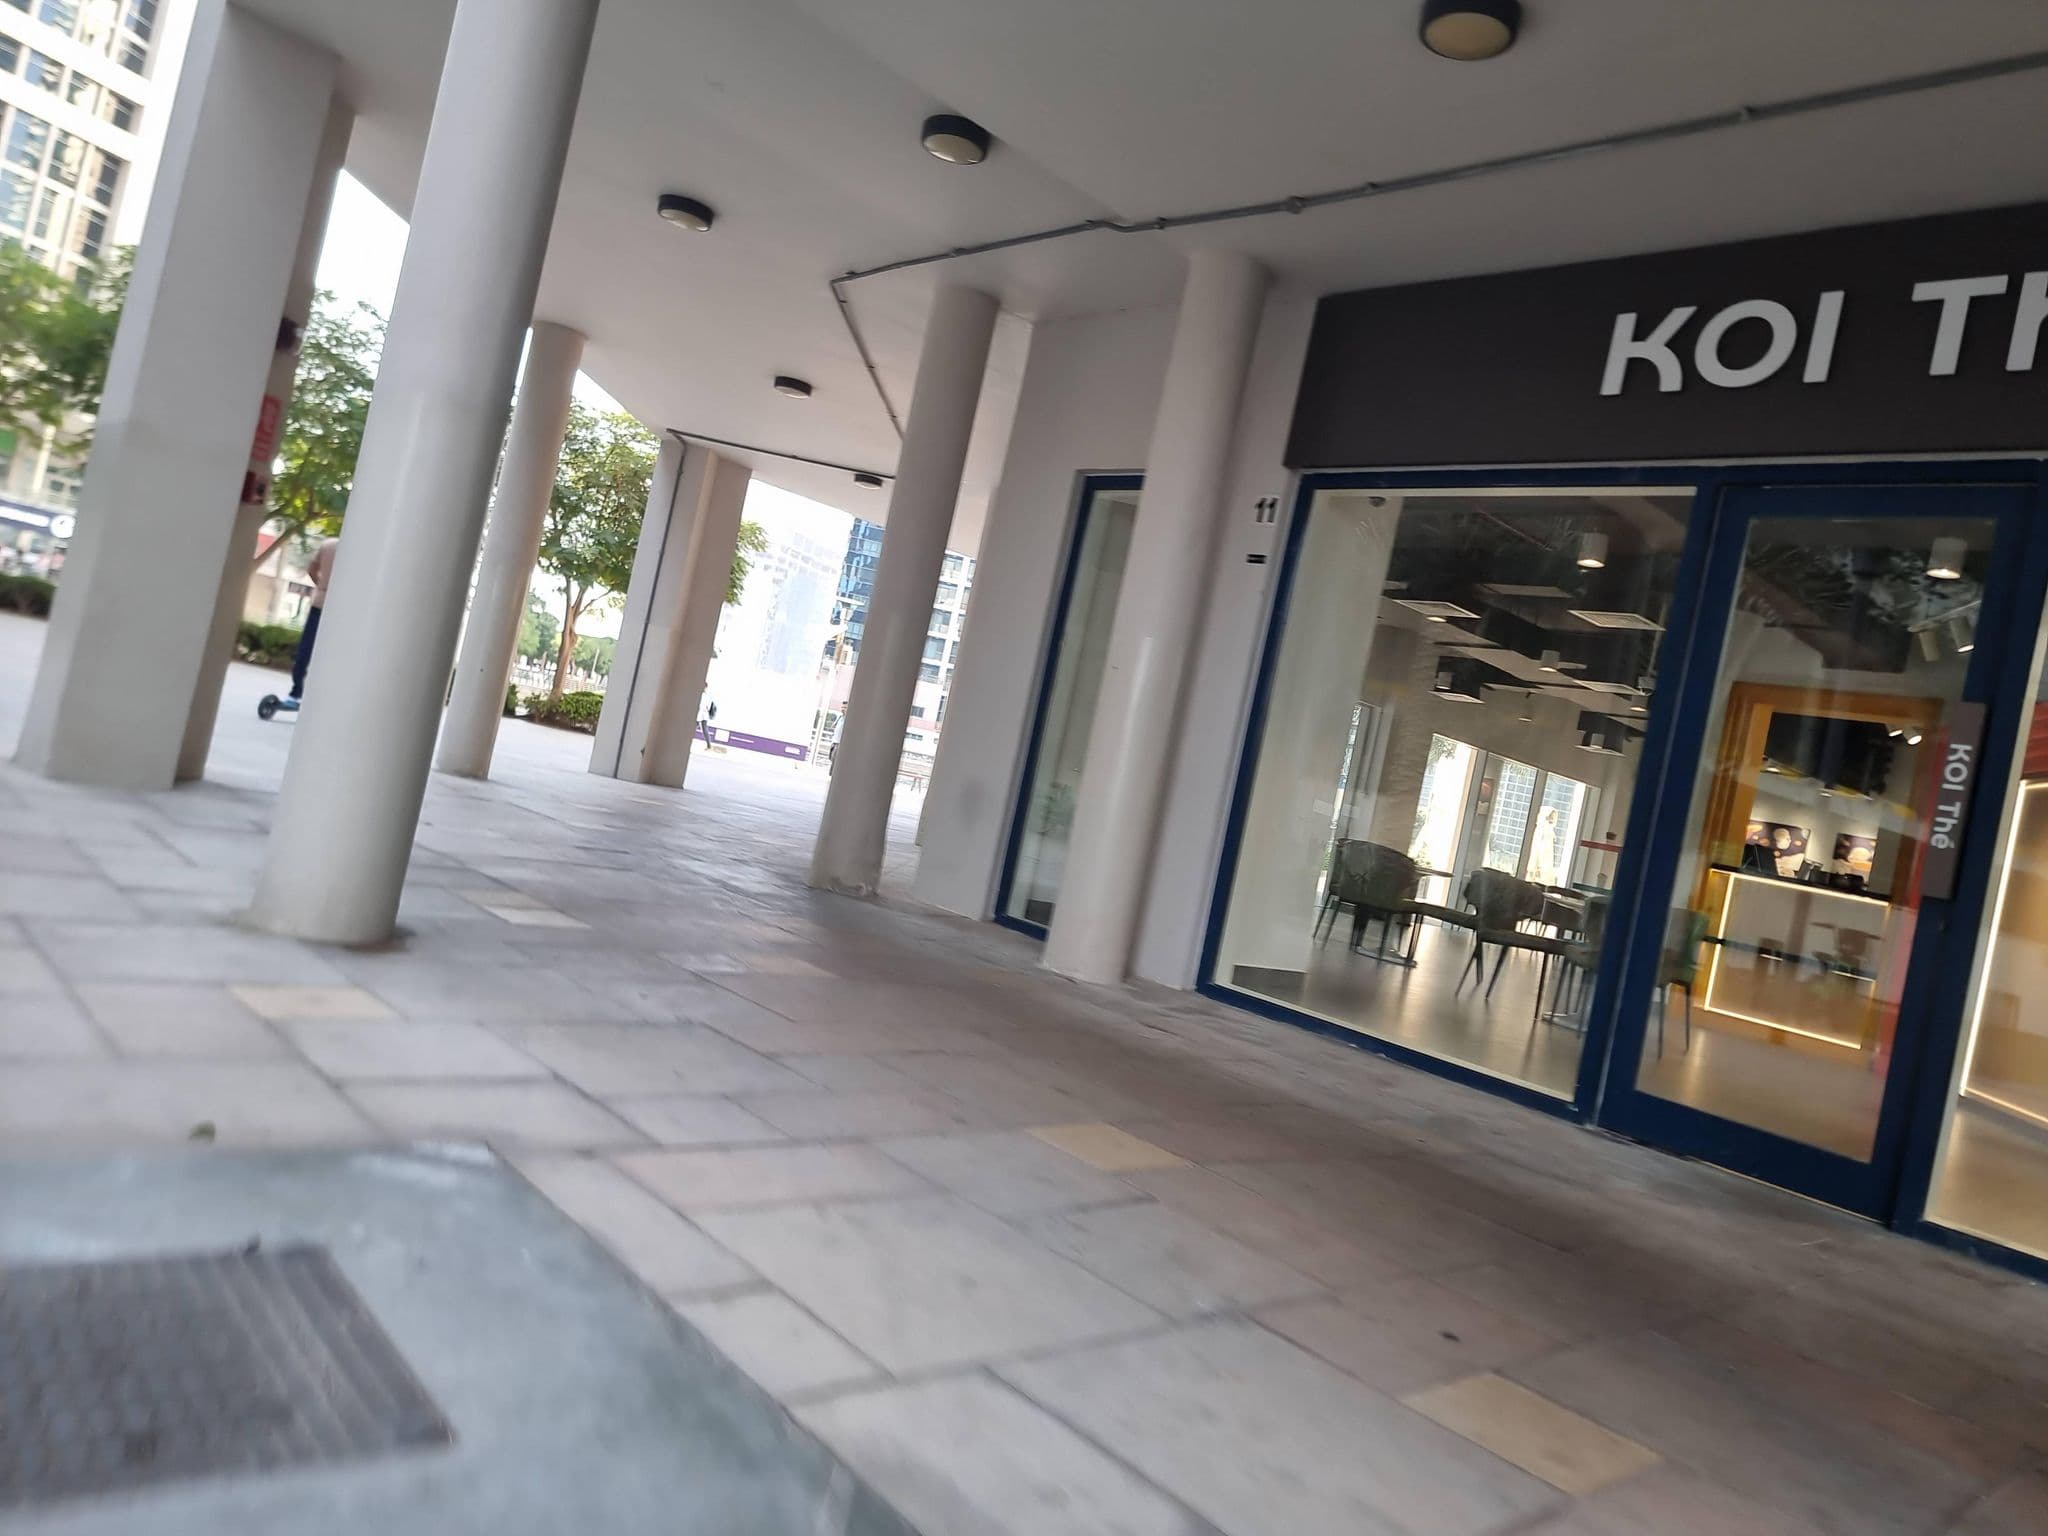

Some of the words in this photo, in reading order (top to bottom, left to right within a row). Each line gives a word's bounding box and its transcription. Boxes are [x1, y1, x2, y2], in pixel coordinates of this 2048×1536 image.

[1599, 290, 1845, 396] KOI
[1255, 497, 1279, 523] 11
[1941, 743, 1973, 791] KOI
[1930, 801, 1962, 849] Thé
